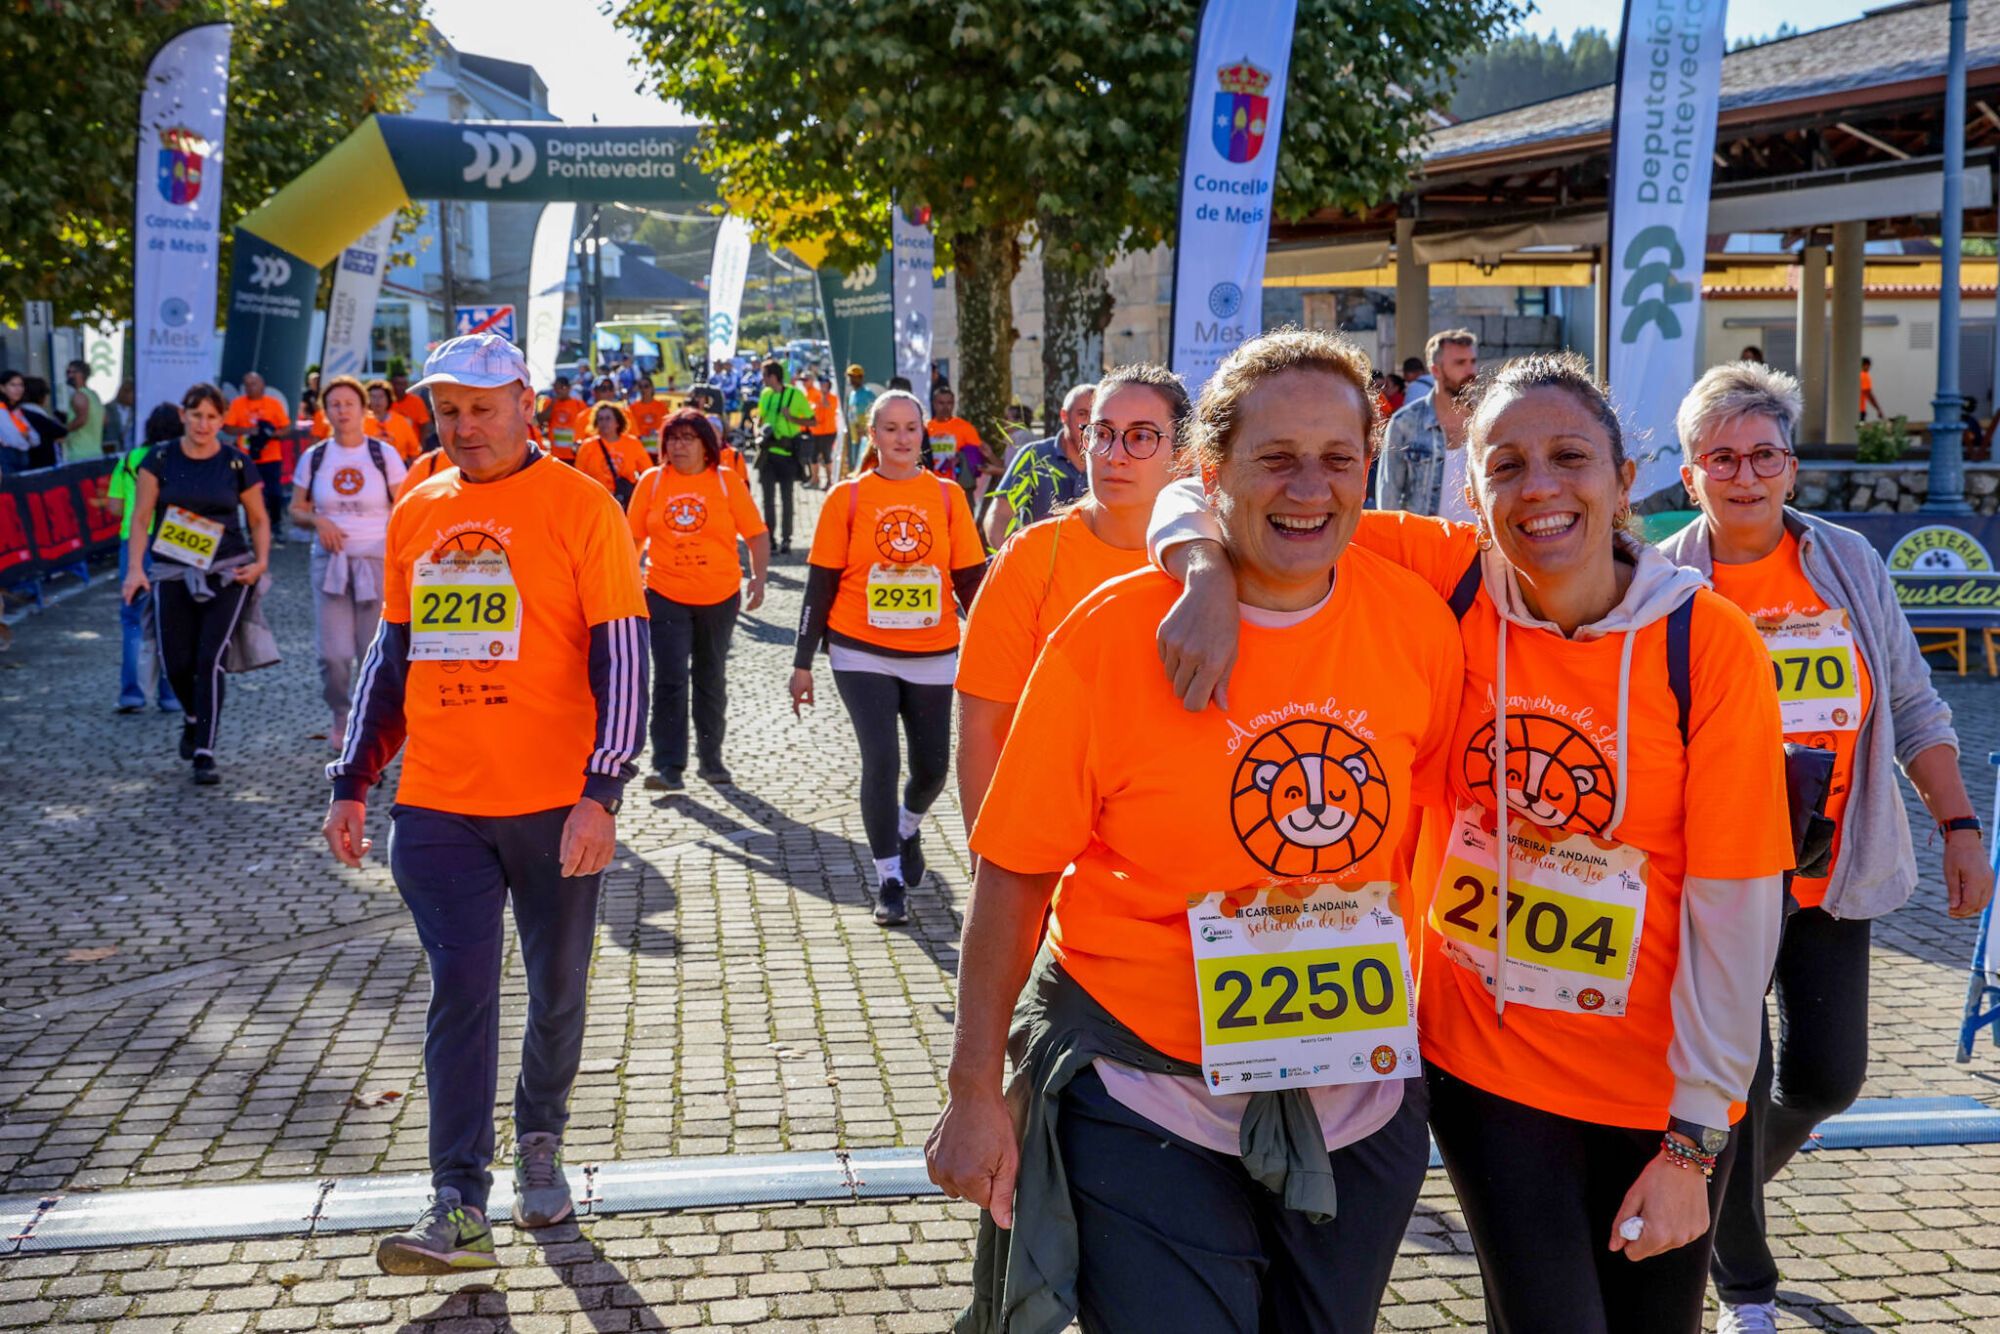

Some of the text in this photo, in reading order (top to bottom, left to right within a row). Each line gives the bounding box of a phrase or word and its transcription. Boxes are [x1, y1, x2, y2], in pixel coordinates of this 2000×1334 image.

[547, 137, 675, 161] Deputación
[547, 159, 676, 178] Pontevedra
[1193, 175, 1269, 196] Concello
[145, 214, 212, 231] Concello
[1196, 204, 1264, 224] de Meis
[149, 238, 208, 253] de Meis
[149, 327, 200, 347] Meis
[163, 525, 213, 554] 2402
[1893, 532, 1984, 570] CAFETERIA
[421, 592, 507, 624] 2218
[874, 587, 932, 608] 2931
[1226, 696, 1378, 756] A carreira de Leo
[1570, 706, 1594, 731] de
[1506, 834, 1547, 854] ARREIRA
[1549, 846, 1556, 856] E
[1558, 850, 1609, 868] ANDAINA
[1560, 860, 1581, 878] de
[1583, 864, 1607, 886] Leo
[1235, 900, 1359, 919] III CARREIRA E ANDAINA
[1443, 875, 1618, 965] 2704
[1248, 914, 1316, 937] solidaria
[1318, 910, 1336, 930] de
[1340, 910, 1359, 932] Leo
[1214, 957, 1395, 1030] 2250
